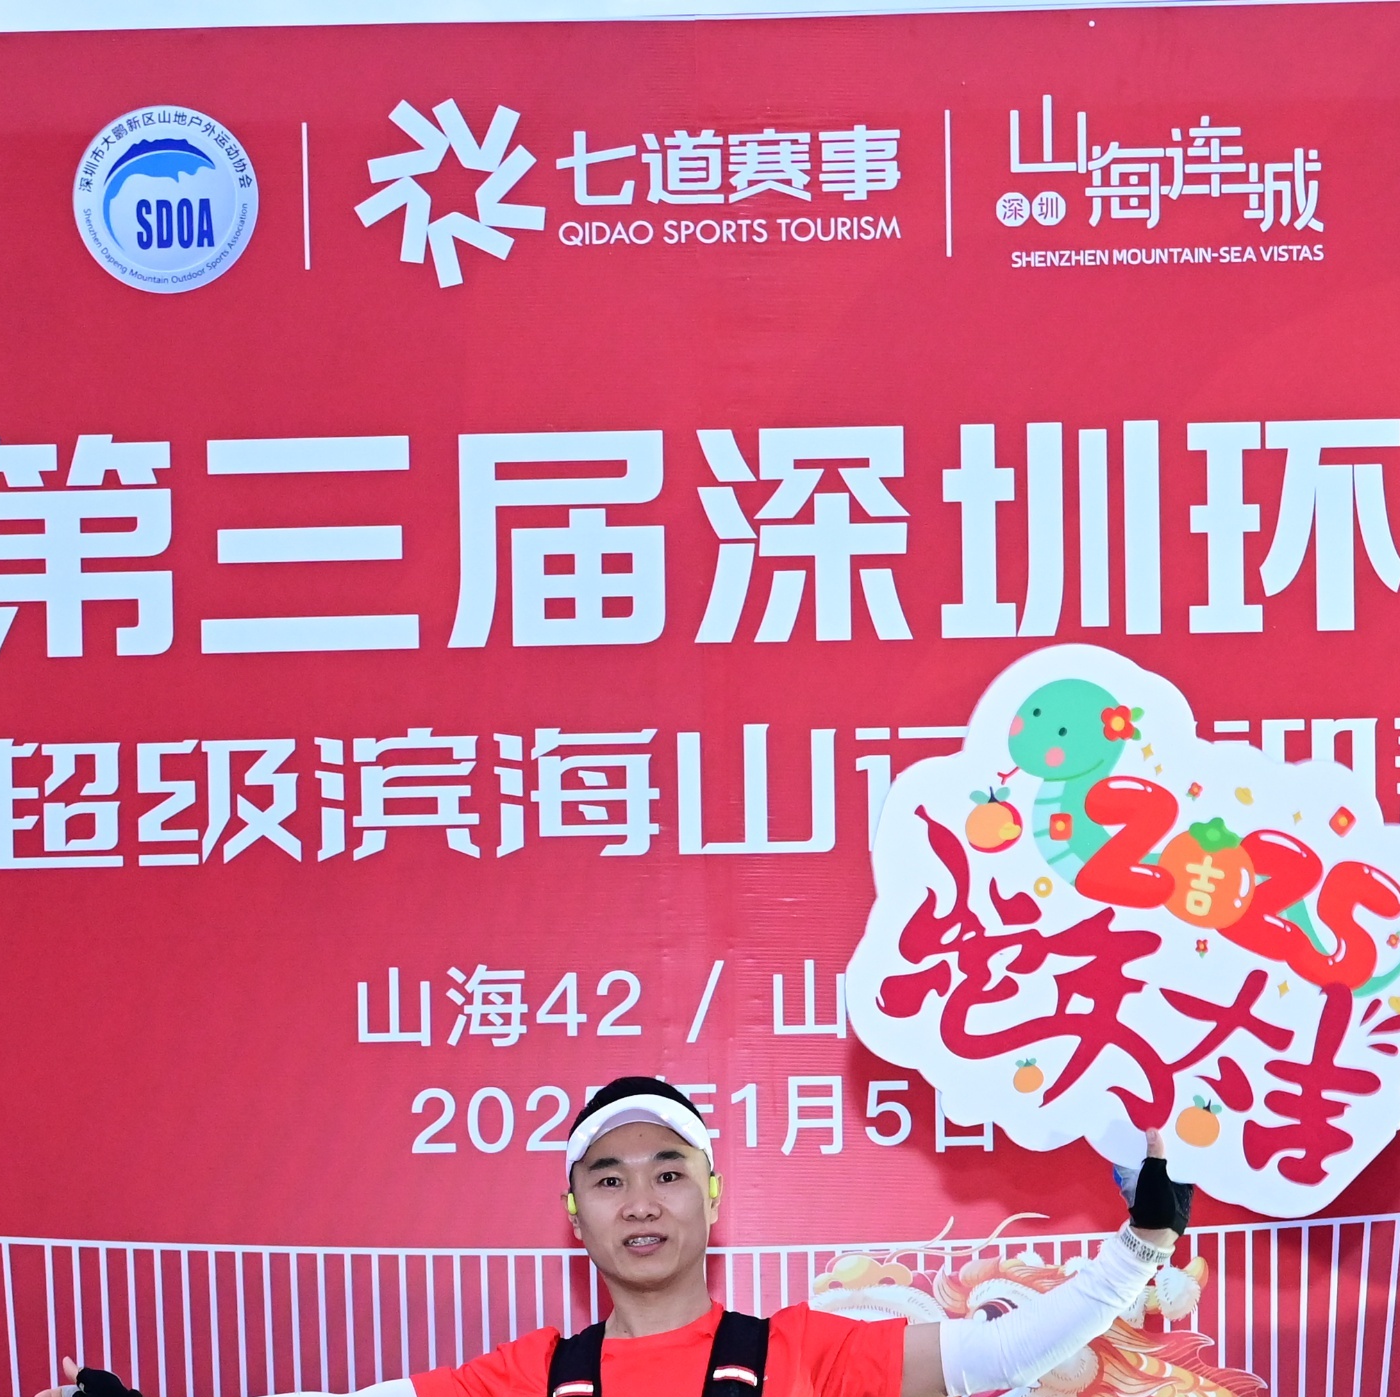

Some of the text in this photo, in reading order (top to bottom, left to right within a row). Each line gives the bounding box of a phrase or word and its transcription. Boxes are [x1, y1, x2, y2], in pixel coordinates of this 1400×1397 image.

[556, 124, 901, 206] 七道赛事
[1009, 94, 1324, 233] 山海连城
[136, 198, 215, 250] SDOA
[558, 215, 902, 247] QIDAO SPORTS TOURISM
[999, 194, 1062, 223] 深圳
[129, 268, 169, 284] Mountain
[171, 267, 206, 284] Outdoor
[1011, 244, 1325, 268] SHENZHEN MOUNTAIN-SEA VISTAS
[356, 962, 642, 1048] 山海42
[411, 1075, 994, 1158] 2021月5
